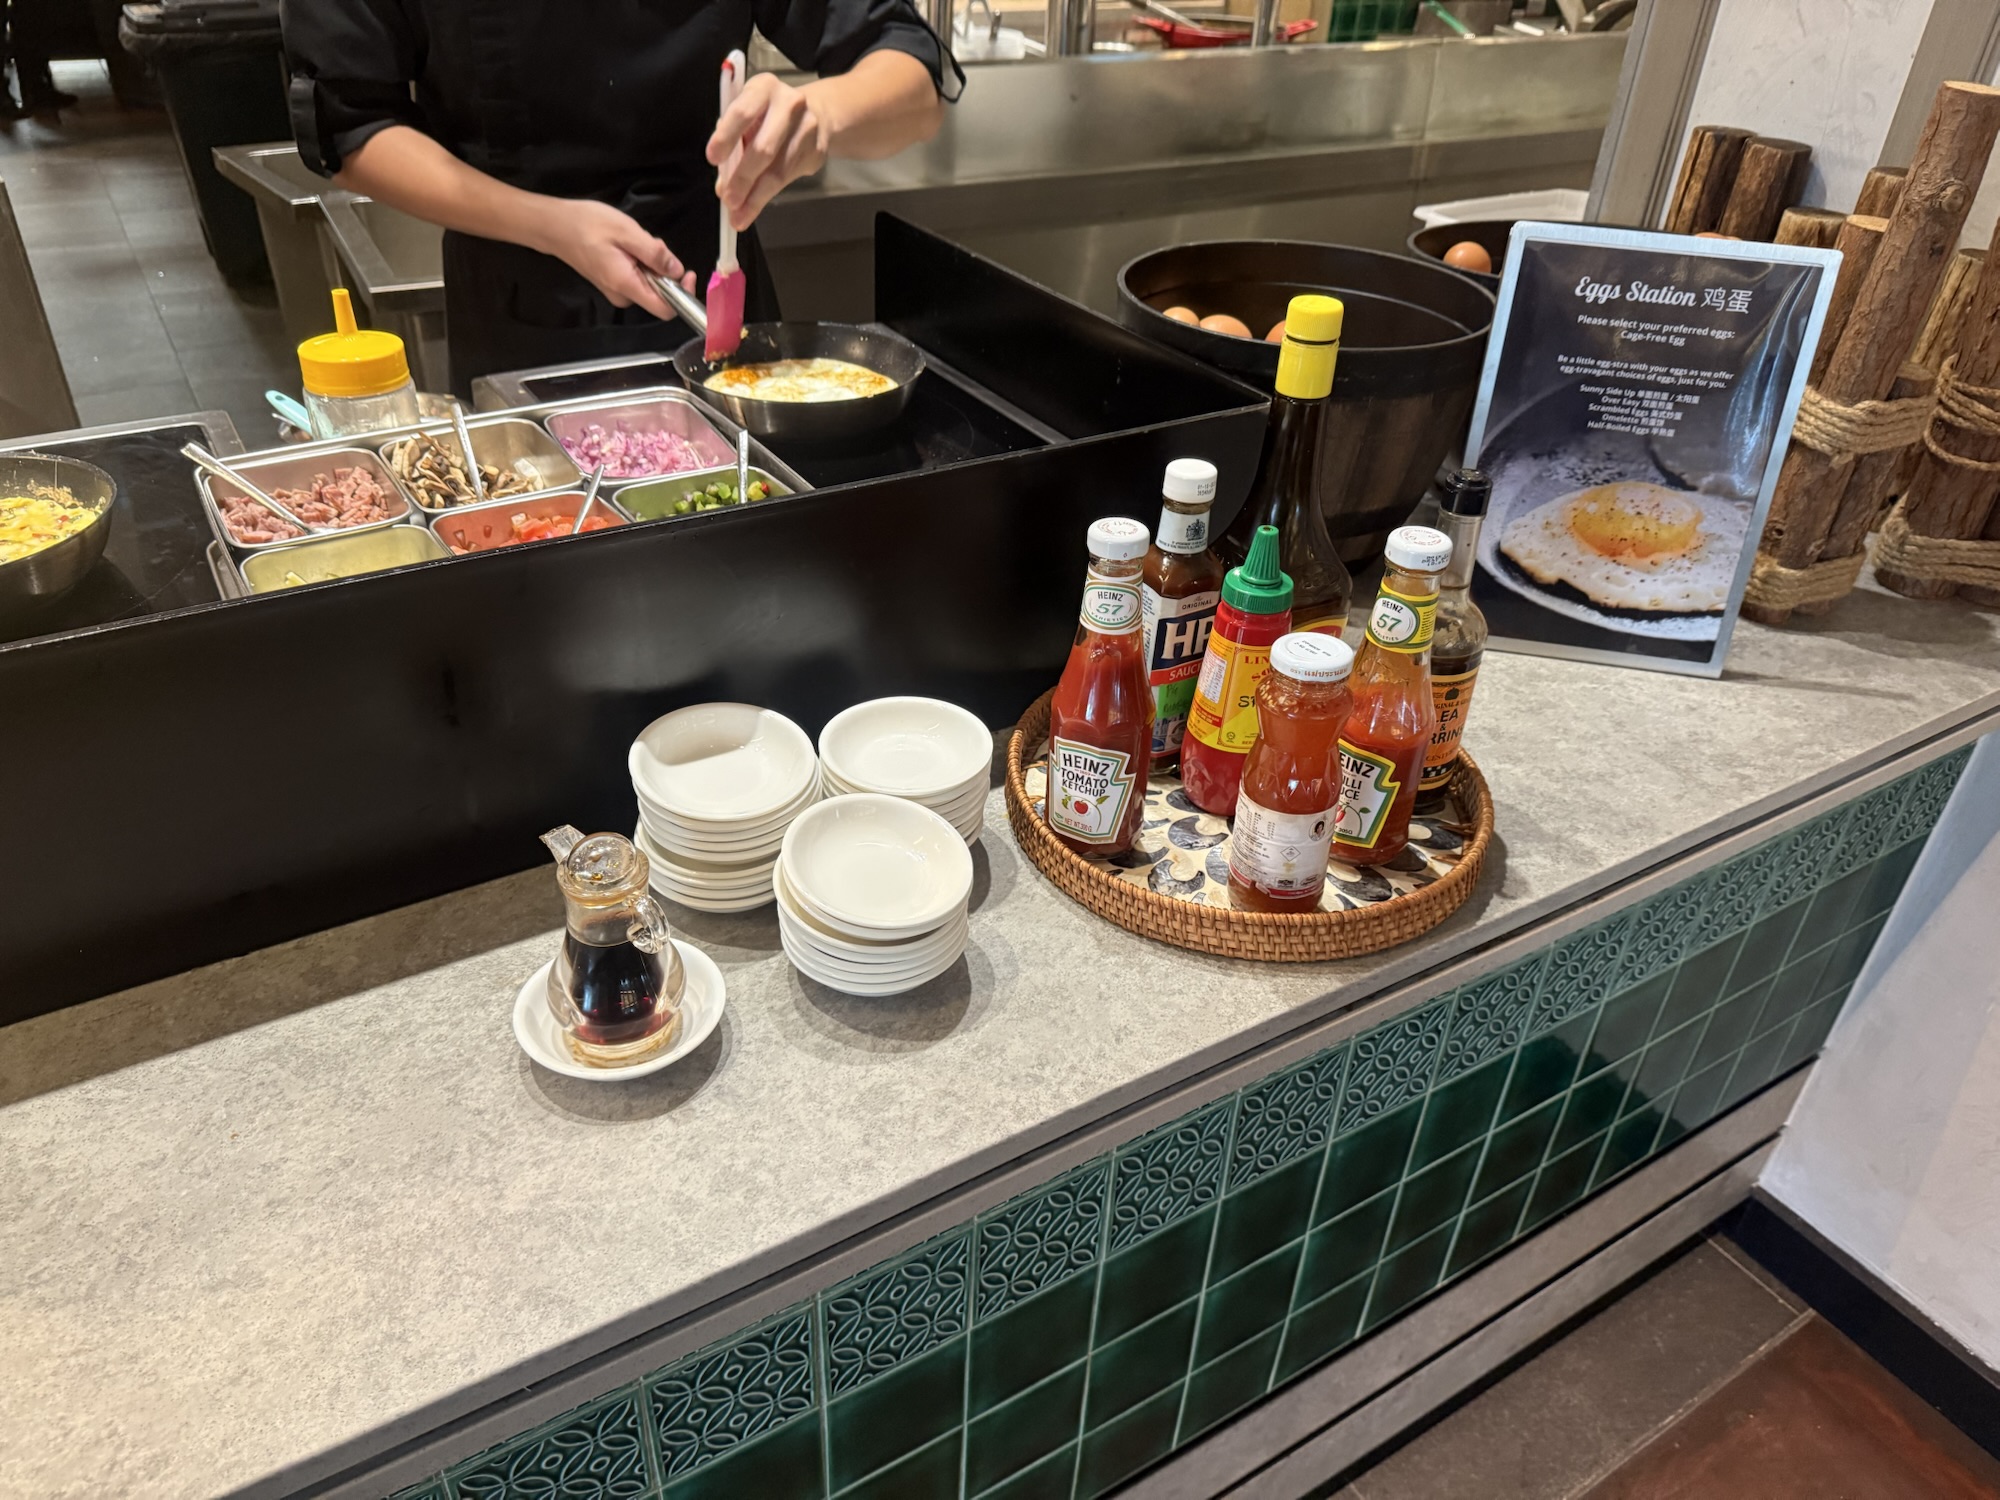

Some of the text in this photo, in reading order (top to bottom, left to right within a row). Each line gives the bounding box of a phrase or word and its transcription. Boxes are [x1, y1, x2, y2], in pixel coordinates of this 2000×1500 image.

[1575, 276, 1753, 314] Eggs Station 鸡蛋
[1577, 314, 1736, 340] Please select your preferred eggs:
[1621, 330, 1686, 347] Cage-Free Egg
[1557, 354, 1568, 363] Be
[1576, 356, 1596, 365] little
[1596, 359, 1629, 369] egg-stra
[1630, 362, 1648, 371] with
[1649, 365, 1668, 374] your
[1669, 367, 1688, 376] eggs
[1689, 369, 1699, 377] as
[1713, 371, 1735, 380] offer
[1560, 365, 1615, 378] egg-travagant
[1616, 370, 1645, 380] choices
[1647, 373, 1657, 381] of
[1677, 376, 1694, 386] just
[1695, 378, 1708, 387] for
[1708, 381, 1727, 390] you.
[1580, 383, 1605, 395] Sunny
[1605, 386, 1623, 395] Side
[1624, 389, 1636, 398] Up
[1601, 395, 1622, 405] Over
[1622, 398, 1640, 408] Easy
[1588, 403, 1631, 414] Scrambled
[1631, 407, 1649, 417] Eggs
[1601, 413, 1640, 424] Omelette
[1587, 420, 1631, 432] Half-Boiled
[1631, 425, 1650, 435] Eggs
[1097, 591, 1124, 602] HEINZ
[1096, 603, 1124, 615] 57
[1182, 599, 1212, 610] ORIGINAL
[1381, 599, 1404, 614] HEINZ
[1376, 613, 1402, 632] 57
[1436, 708, 1458, 723] EA
[1440, 723, 1447, 731] &
[1063, 753, 1110, 776] HEINZ
[1339, 753, 1375, 778] EINZ
[1061, 767, 1109, 789] TOMATO
[1342, 775, 1362, 790] ILLI
[1062, 779, 1106, 797] KETCHUP
[1340, 786, 1360, 800] UCE
